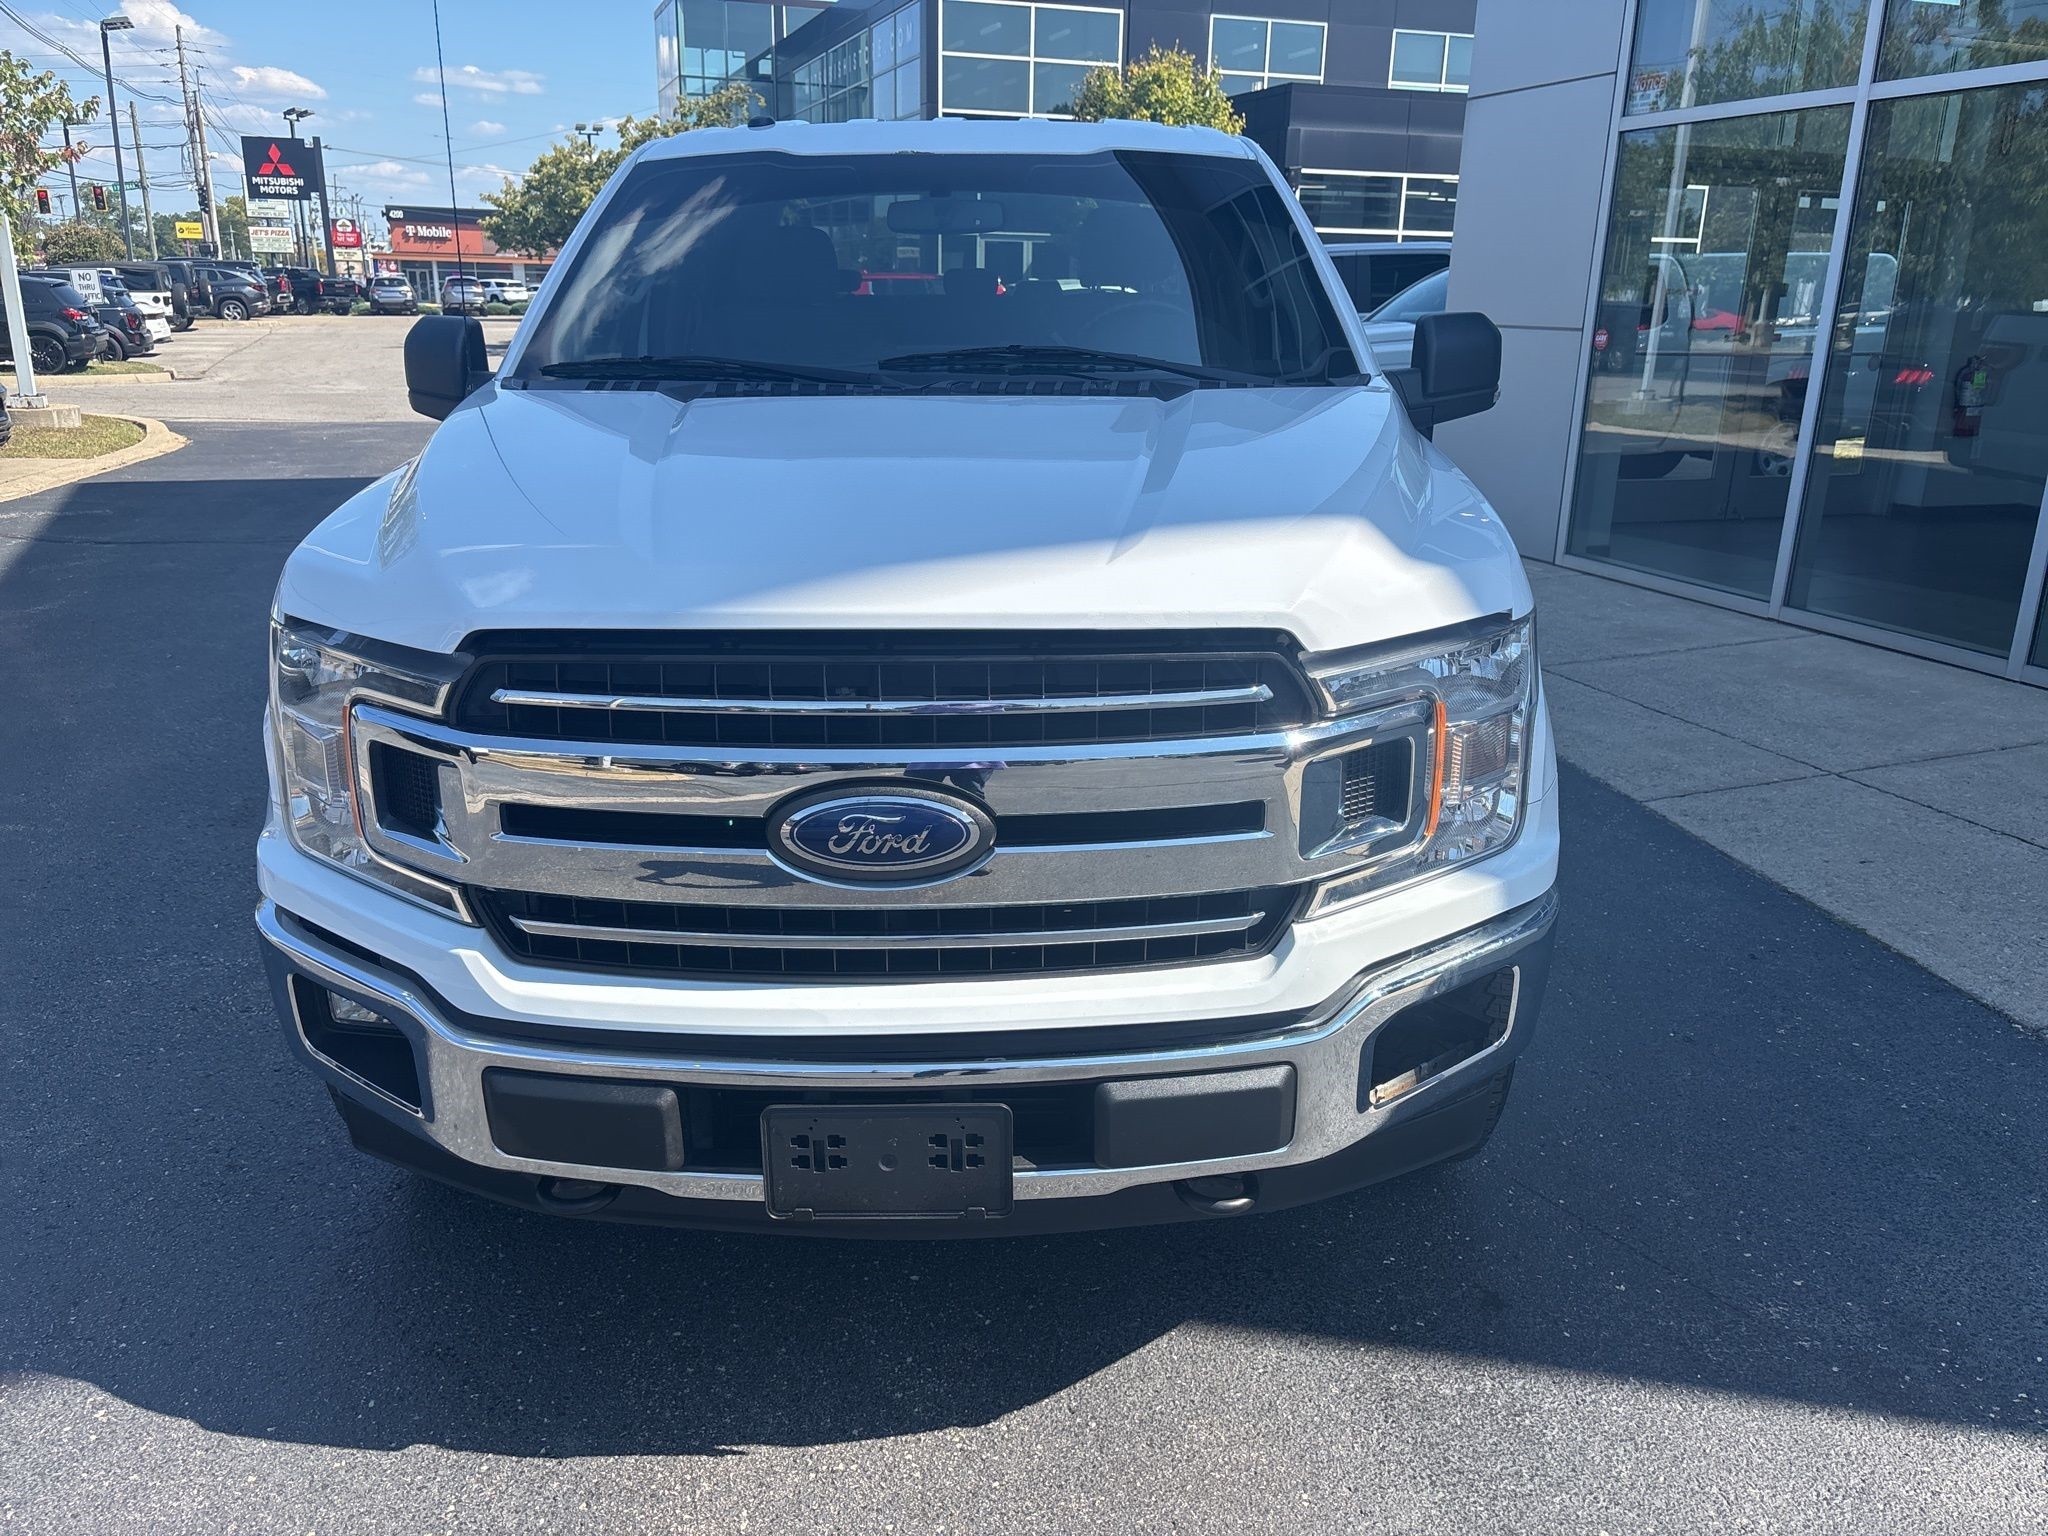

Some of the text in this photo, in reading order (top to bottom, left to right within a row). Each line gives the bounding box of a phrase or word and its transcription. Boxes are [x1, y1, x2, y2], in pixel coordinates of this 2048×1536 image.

[252, 176, 304, 187] MITSUBISHI
[260, 185, 299, 195] MOTORS
[270, 229, 290, 237] PIZZA
[78, 272, 92, 281] NO
[828, 813, 934, 854] Ford
